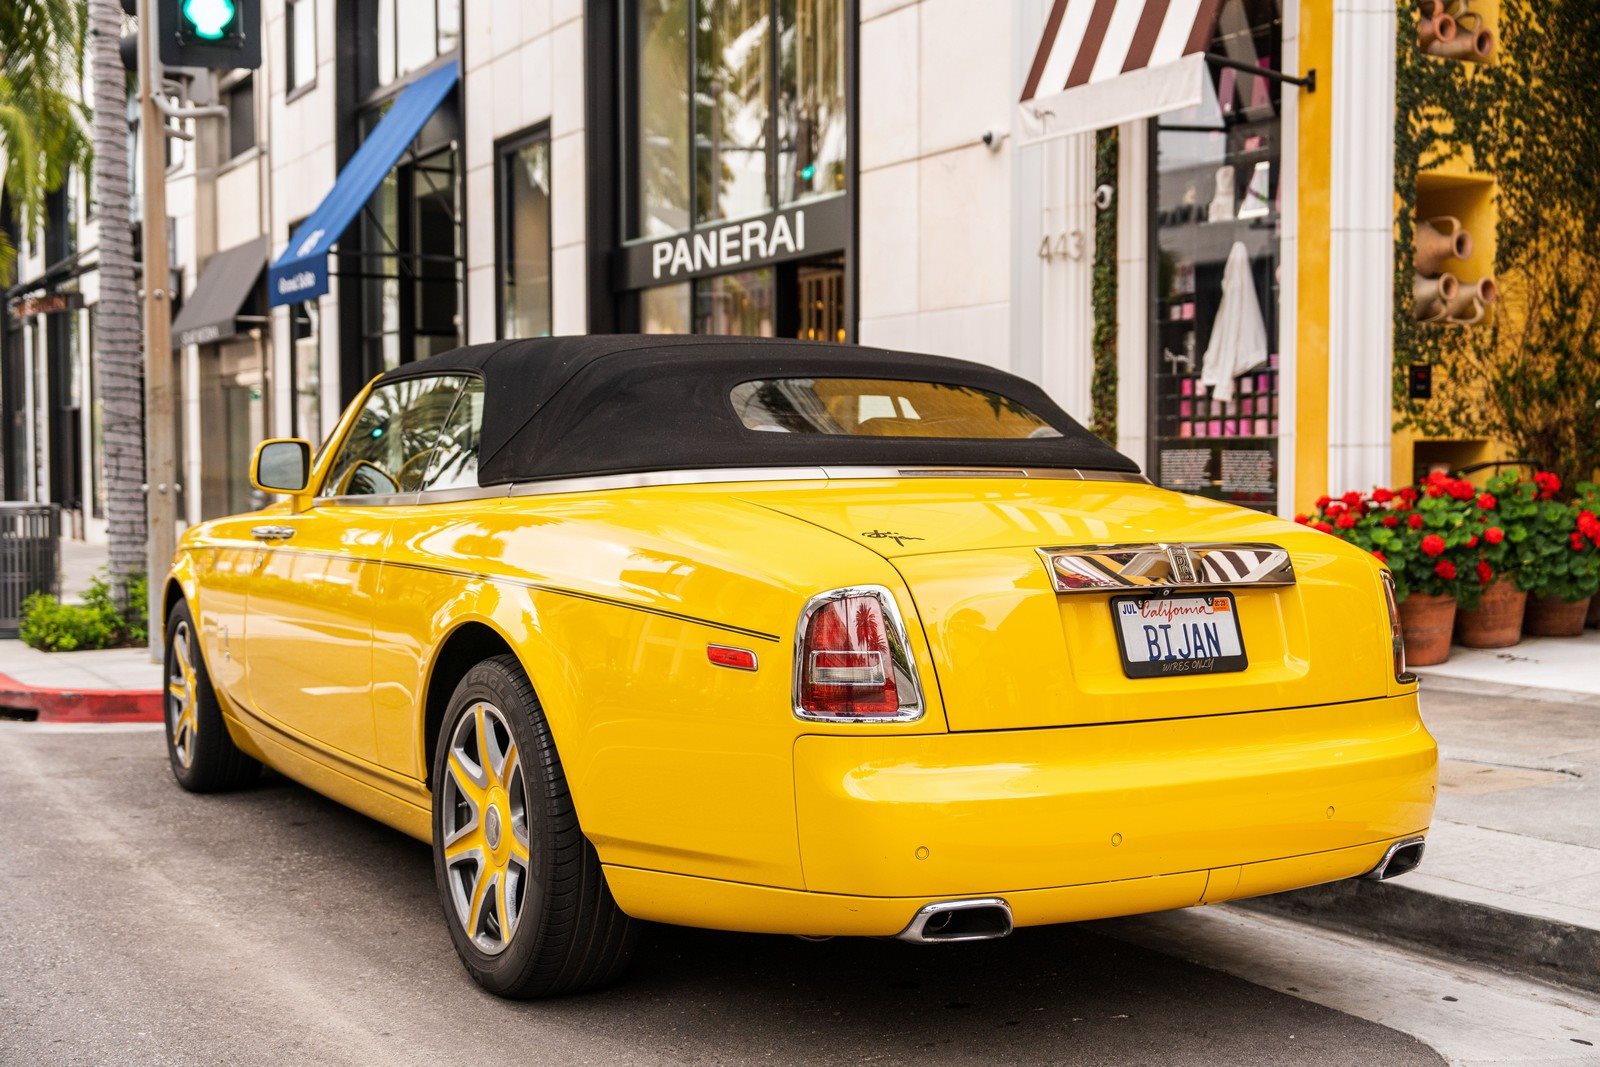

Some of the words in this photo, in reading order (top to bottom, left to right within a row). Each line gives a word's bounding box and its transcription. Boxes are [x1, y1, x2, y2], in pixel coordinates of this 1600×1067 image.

[652, 210, 805, 279] PANERAI
[1038, 230, 1084, 265] 443
[1122, 603, 1137, 615] JUL
[1141, 599, 1214, 622] California
[1143, 622, 1222, 661] BIJAN
